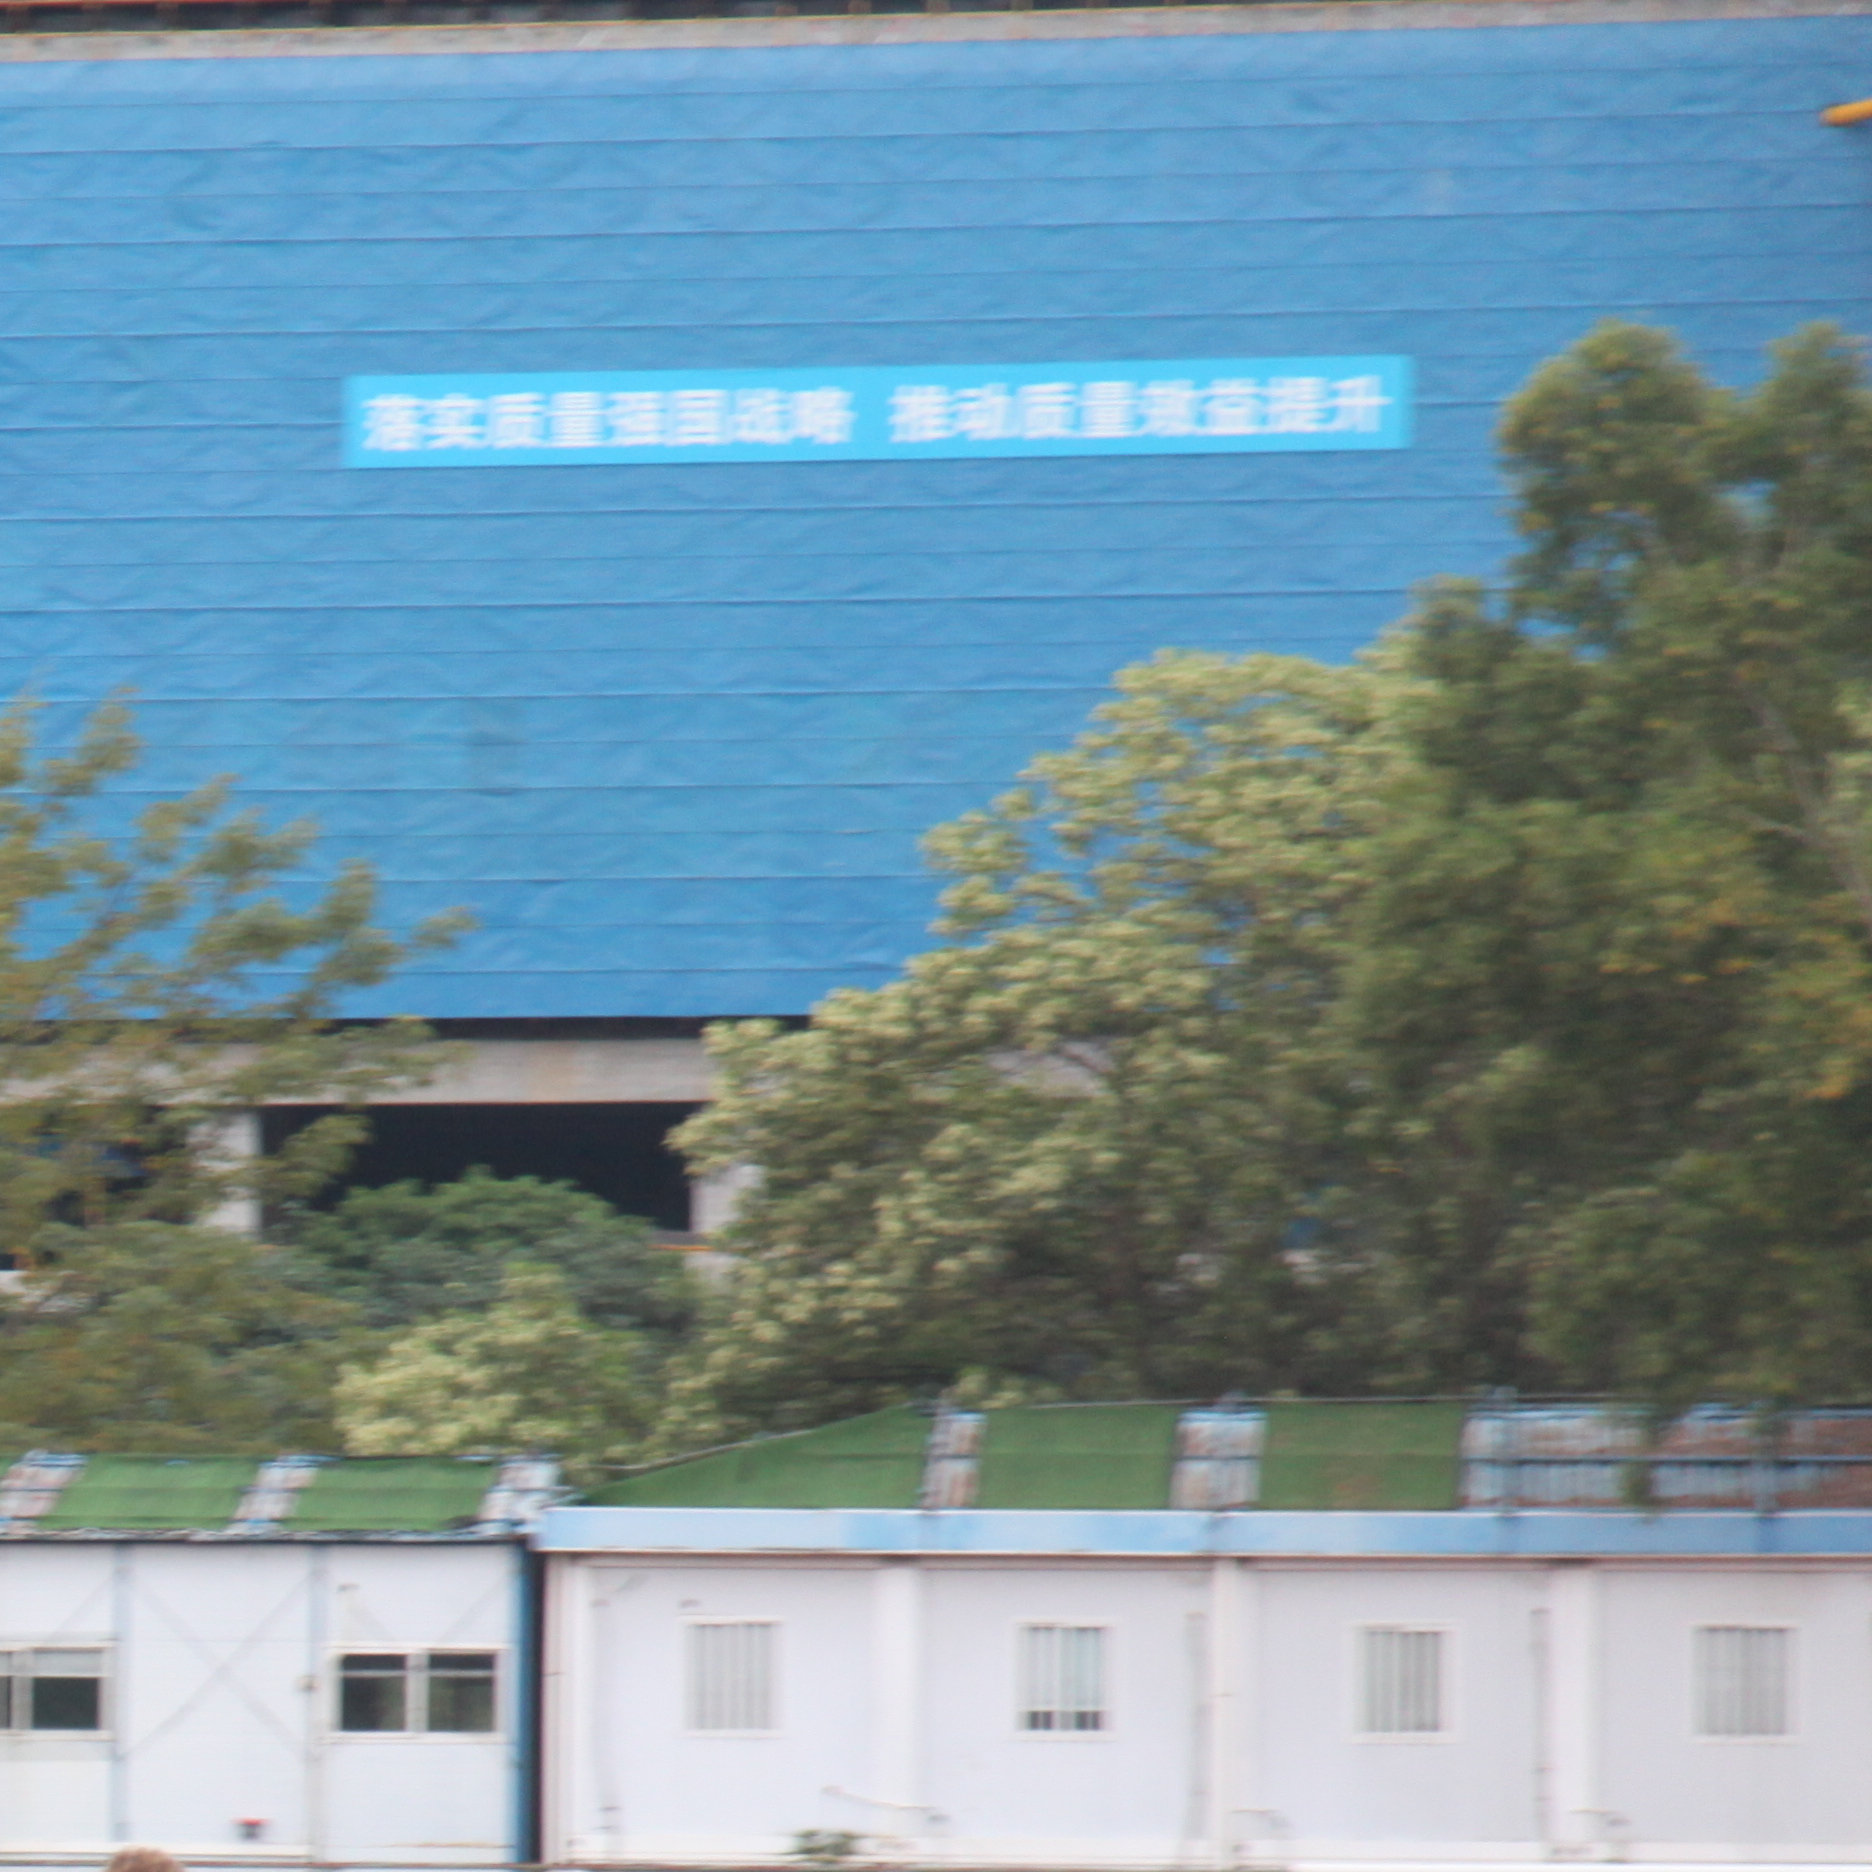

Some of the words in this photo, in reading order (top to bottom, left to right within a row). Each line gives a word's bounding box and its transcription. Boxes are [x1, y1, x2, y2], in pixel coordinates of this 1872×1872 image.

[362, 389, 855, 451] 落实质量强国战略
[889, 375, 1390, 442] 推动质量效益提升
